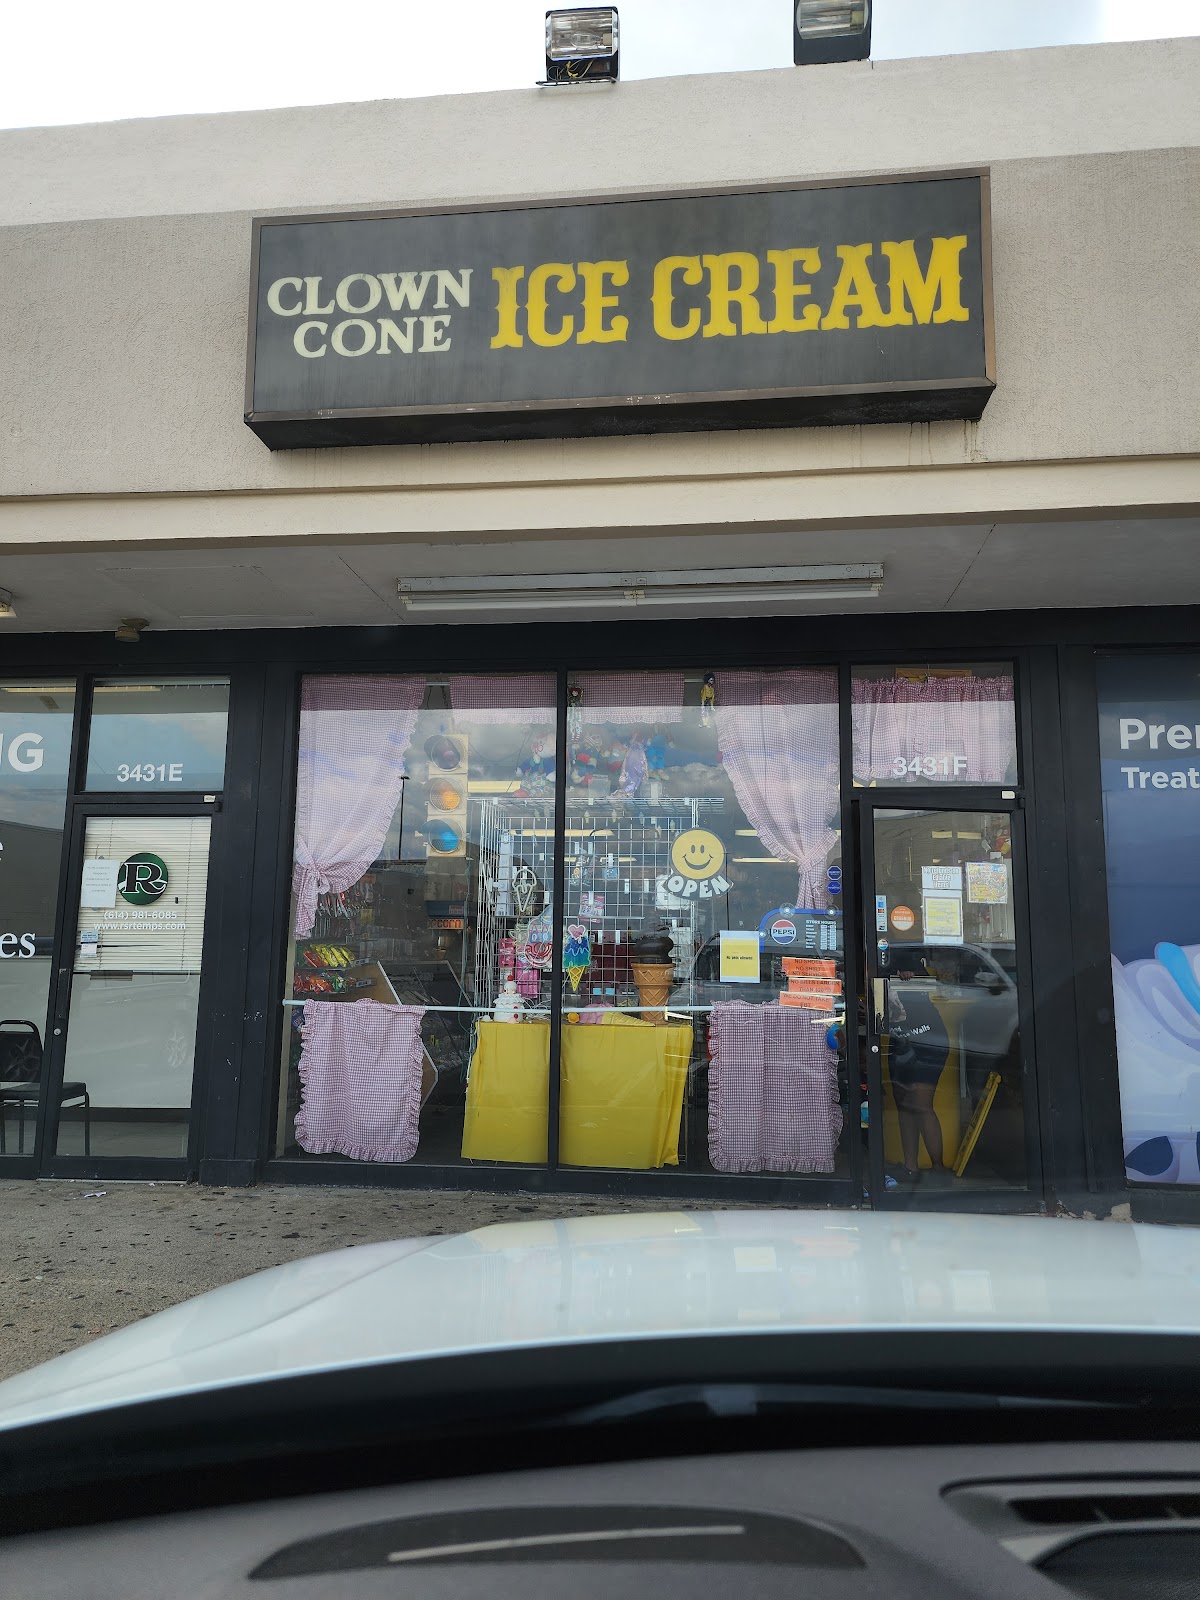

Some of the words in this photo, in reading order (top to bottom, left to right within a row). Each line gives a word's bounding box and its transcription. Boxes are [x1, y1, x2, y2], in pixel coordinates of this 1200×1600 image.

[267, 269, 473, 316] CLOWN
[491, 260, 630, 349] ICE
[651, 234, 970, 341] CREAM
[293, 315, 451, 358] CONE
[116, 763, 184, 783] 3431E
[892, 756, 968, 776] 3431F
[667, 875, 731, 898] OPEN
[104, 910, 129, 920] (614)
[131, 910, 177, 920] 981-6085
[93, 921, 187, 931] www.rsrtemps.com
[772, 928, 796, 936] PEPSI
[910, 1024, 931, 1035] Walls
